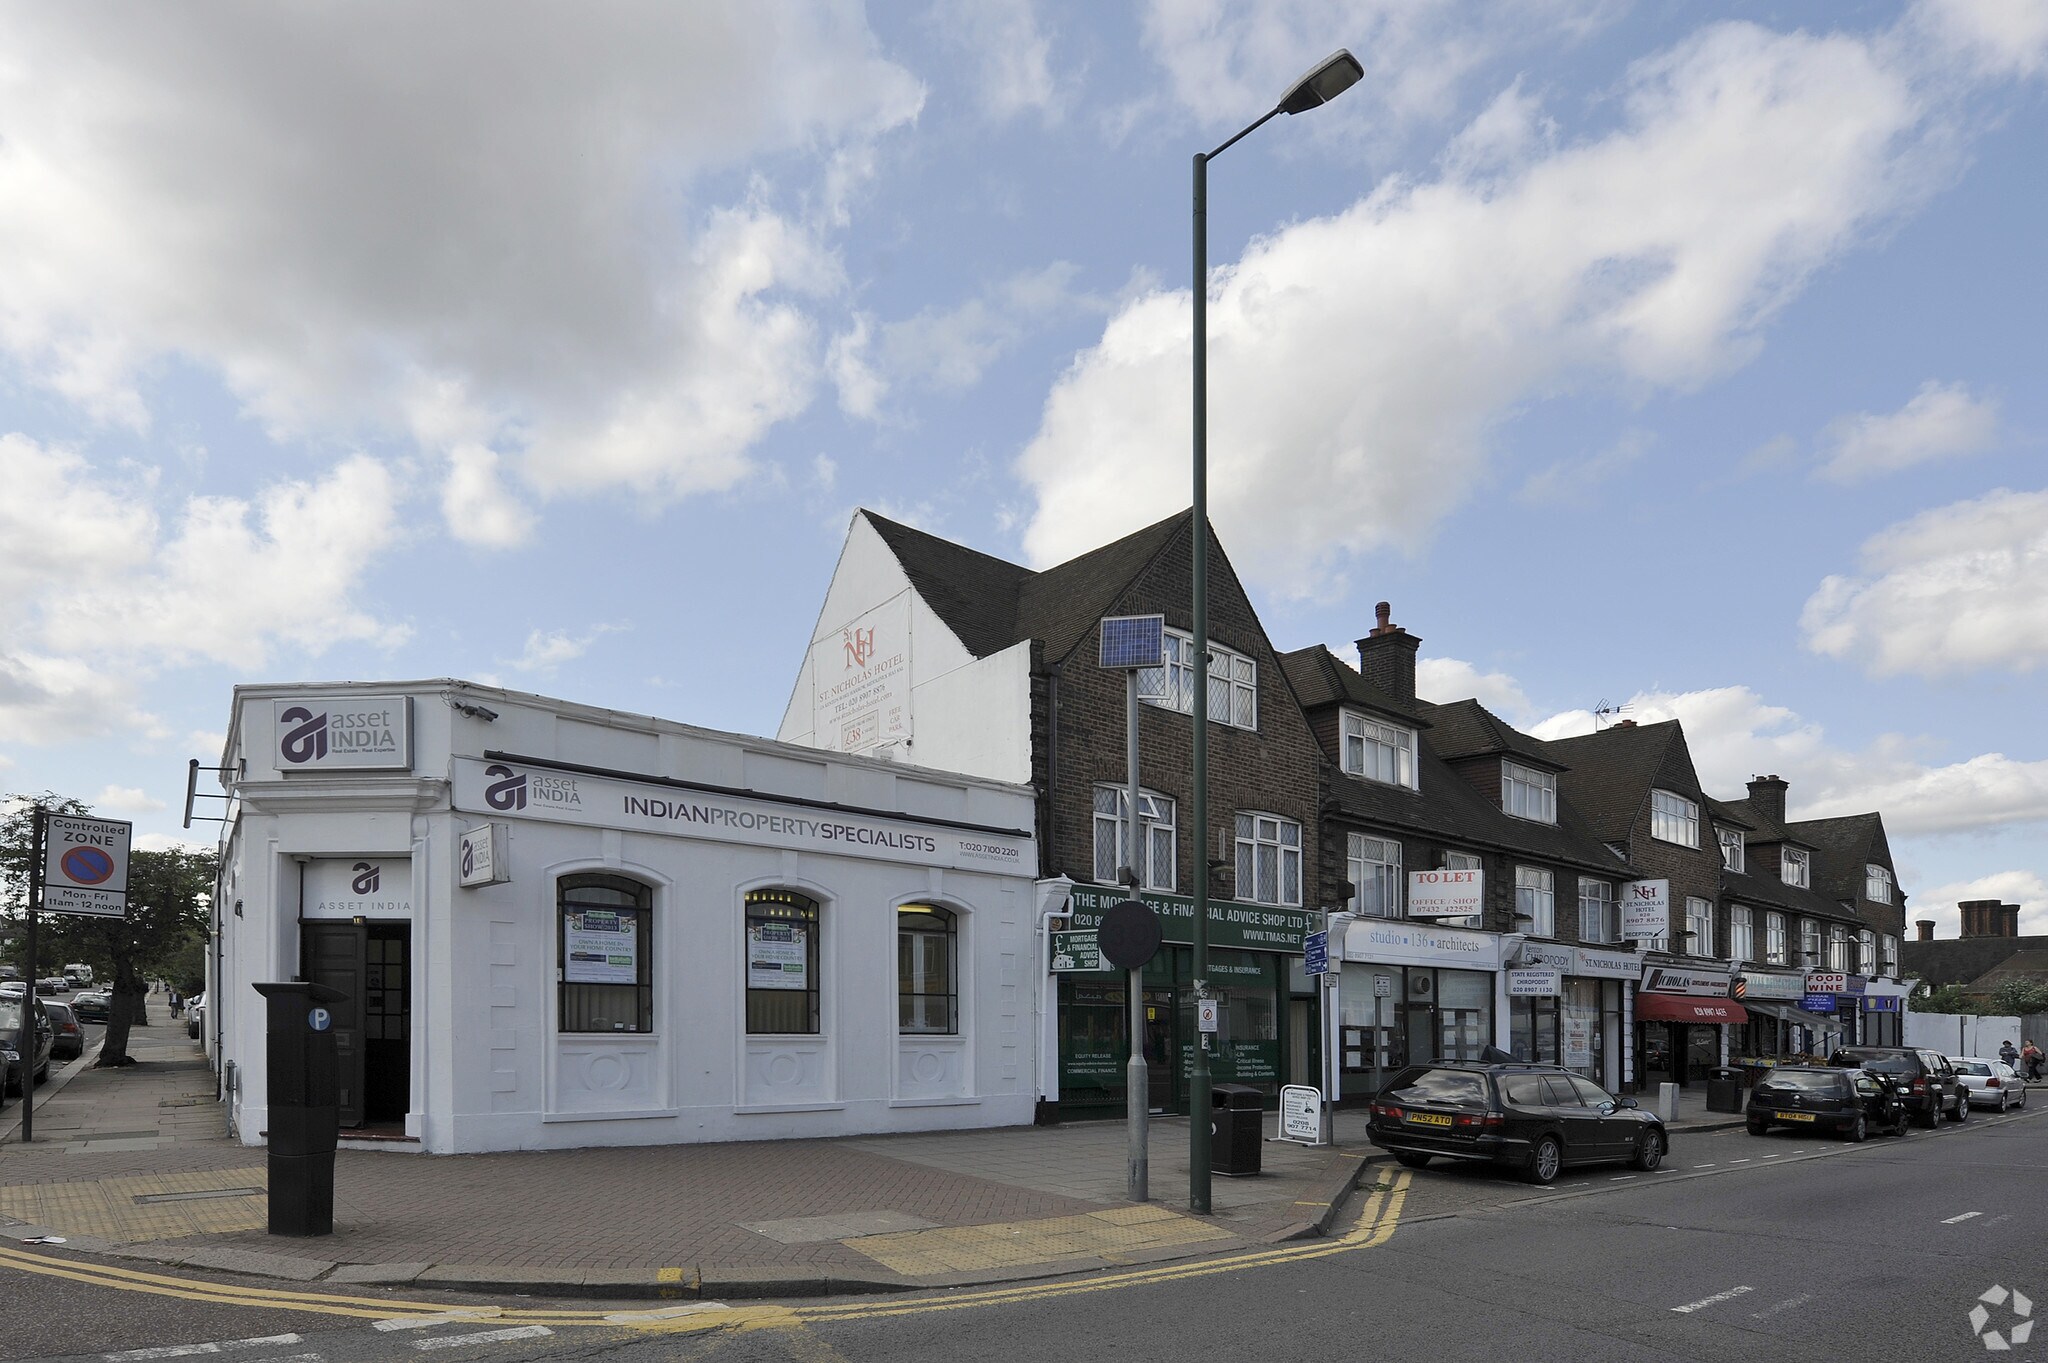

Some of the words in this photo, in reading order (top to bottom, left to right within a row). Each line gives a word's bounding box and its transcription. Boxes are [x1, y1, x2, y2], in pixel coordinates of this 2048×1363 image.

[832, 669, 872, 696] NICHOLAS
[874, 654, 904, 675] HOTEL
[835, 702, 847, 713] TEL:
[331, 710, 390, 728] asset
[331, 730, 395, 747] INDIA
[533, 776, 578, 791] asset
[534, 788, 581, 804] INDIA
[54, 820, 125, 834] Controlled
[64, 832, 114, 846] ZONE
[983, 845, 1000, 854] 7100
[1002, 848, 1018, 856] 2201
[1416, 873, 1439, 883] TO
[1443, 872, 1475, 882] LET
[95, 903, 121, 911] noon
[1075, 893, 1096, 907] THE
[1162, 902, 1170, 915] &
[1227, 910, 1259, 924] ADVICE
[1263, 914, 1285, 926] SHOP
[1288, 916, 1303, 928] LTD
[1075, 914, 1092, 926] 020
[1243, 930, 1301, 944] WWW.TMAS.NET
[1370, 930, 1400, 944] studio
[1411, 933, 1428, 948] 136
[1437, 937, 1479, 952] architects
[1624, 962, 1640, 971] HOTEL
[1412, 1114, 1432, 1122] PN52
[1435, 1116, 1450, 1124] ATO
